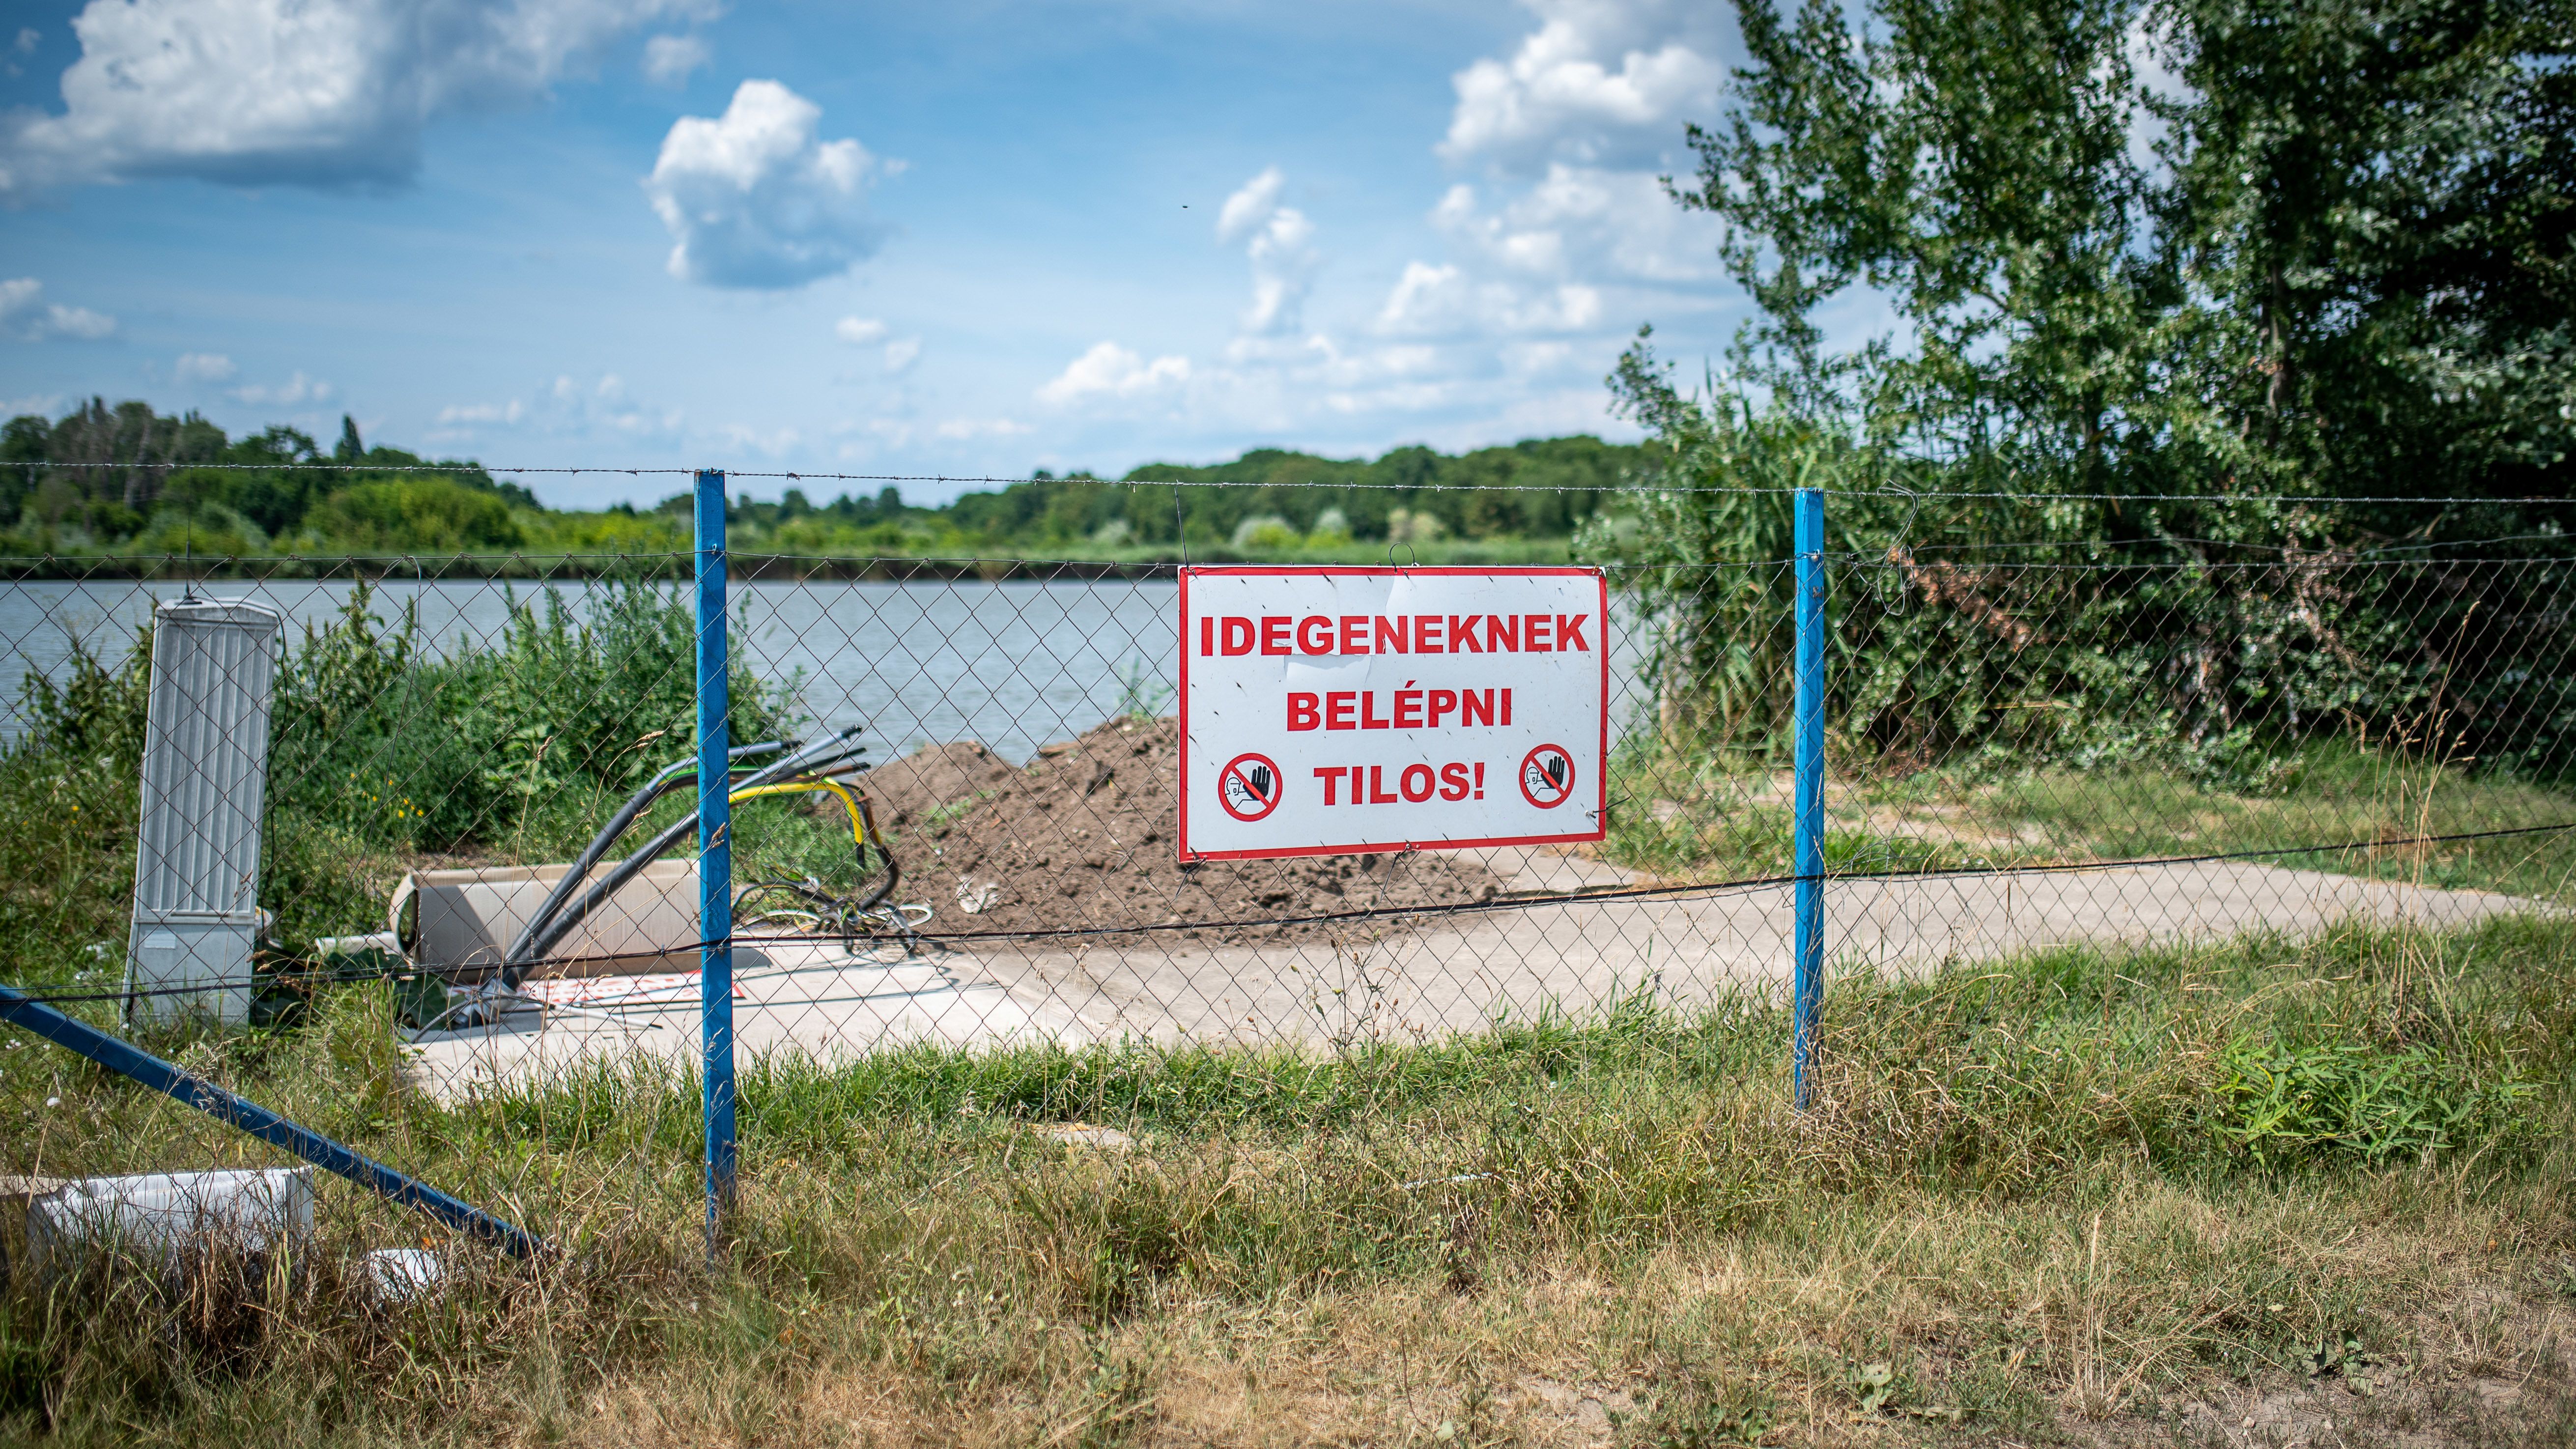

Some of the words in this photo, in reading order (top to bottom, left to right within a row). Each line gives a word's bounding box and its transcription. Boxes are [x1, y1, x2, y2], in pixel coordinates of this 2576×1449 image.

[1201, 614, 1589, 656] IDEGENEKNEK
[1287, 680, 1512, 732] BELÉPNI
[1313, 762, 1485, 806] TILOS!
